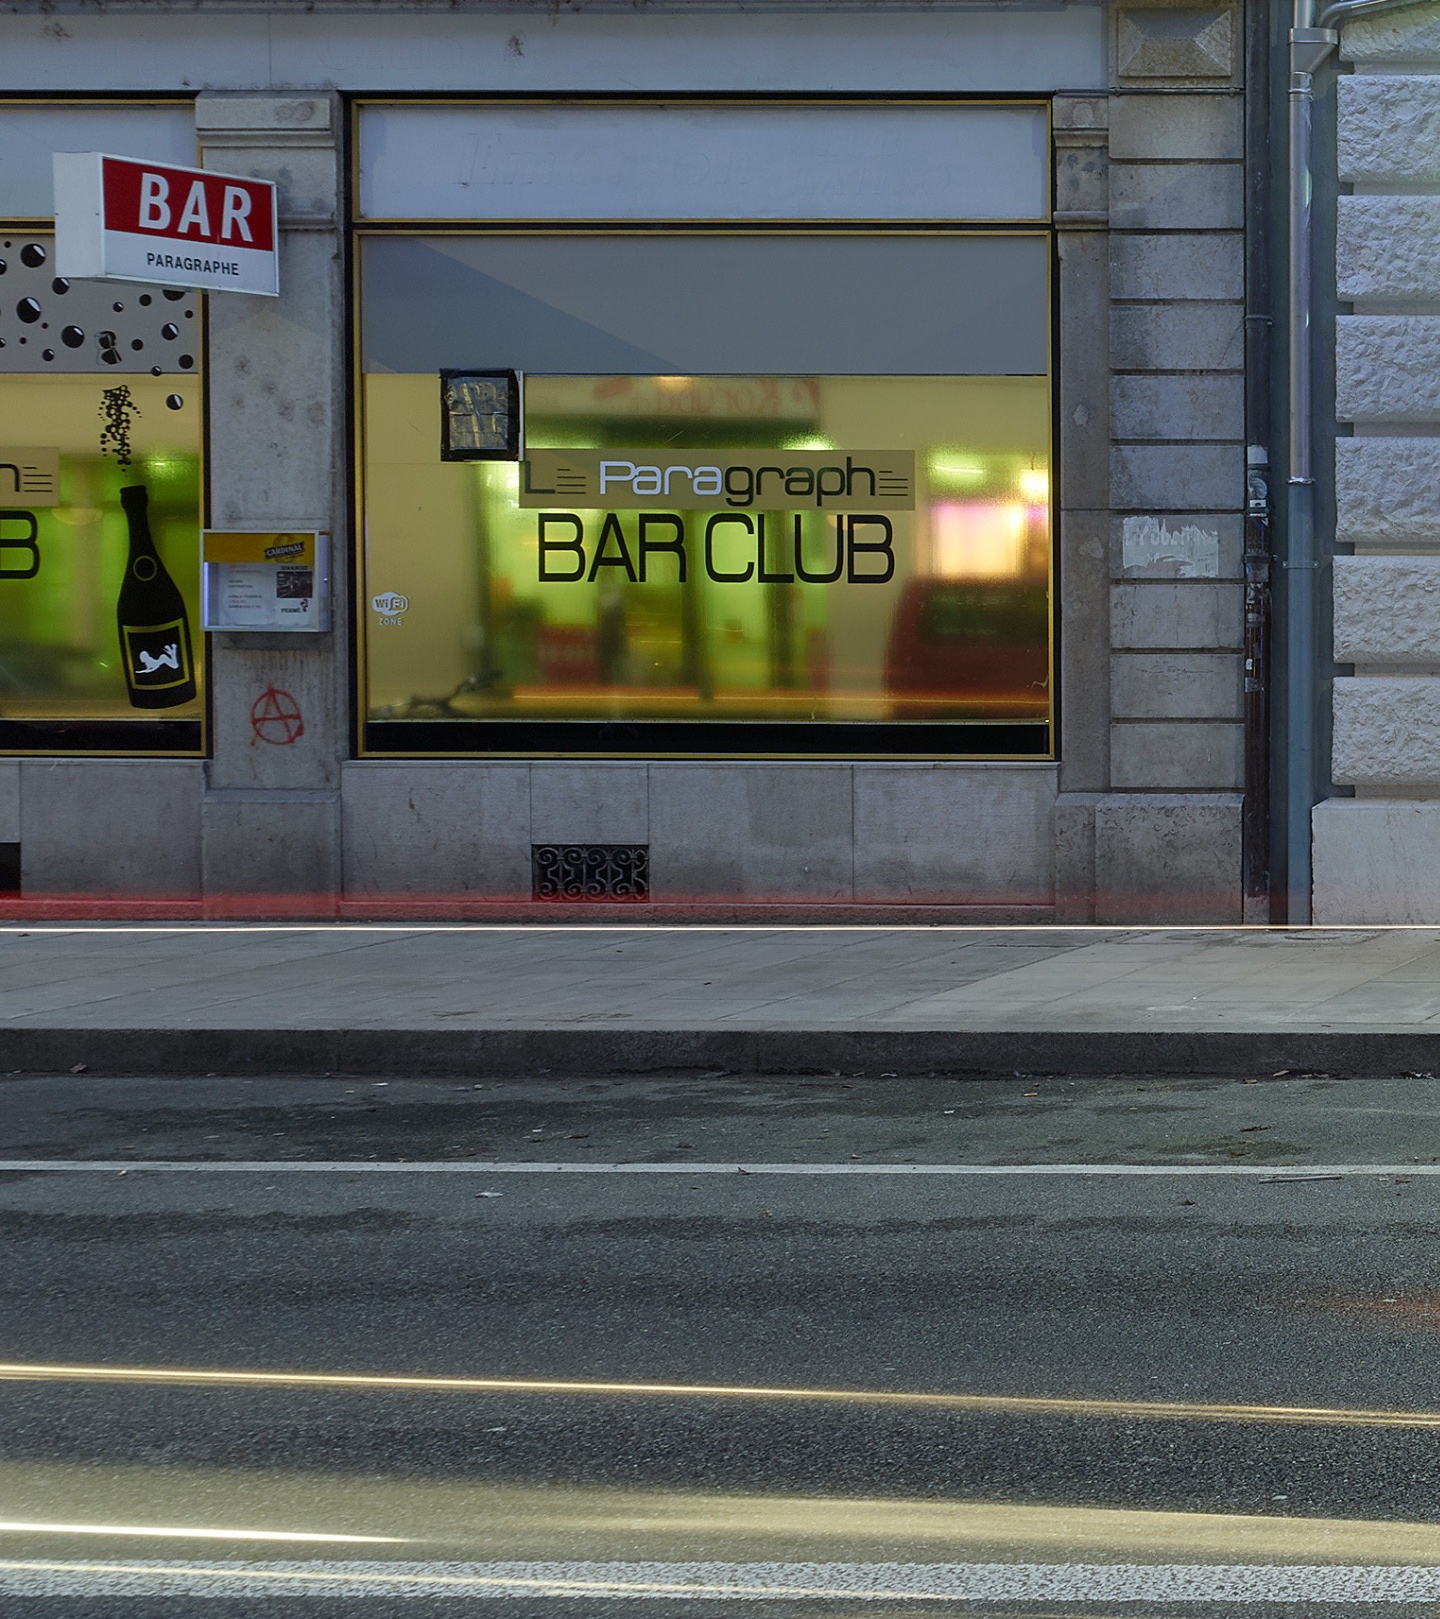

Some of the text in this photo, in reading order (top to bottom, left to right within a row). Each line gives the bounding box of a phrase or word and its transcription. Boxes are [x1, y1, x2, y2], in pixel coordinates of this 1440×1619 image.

[138, 172, 254, 243] BAR
[146, 252, 240, 276] PARAGRAPHE
[538, 512, 896, 583] BAR CLUB
[378, 617, 403, 626] ZONE
